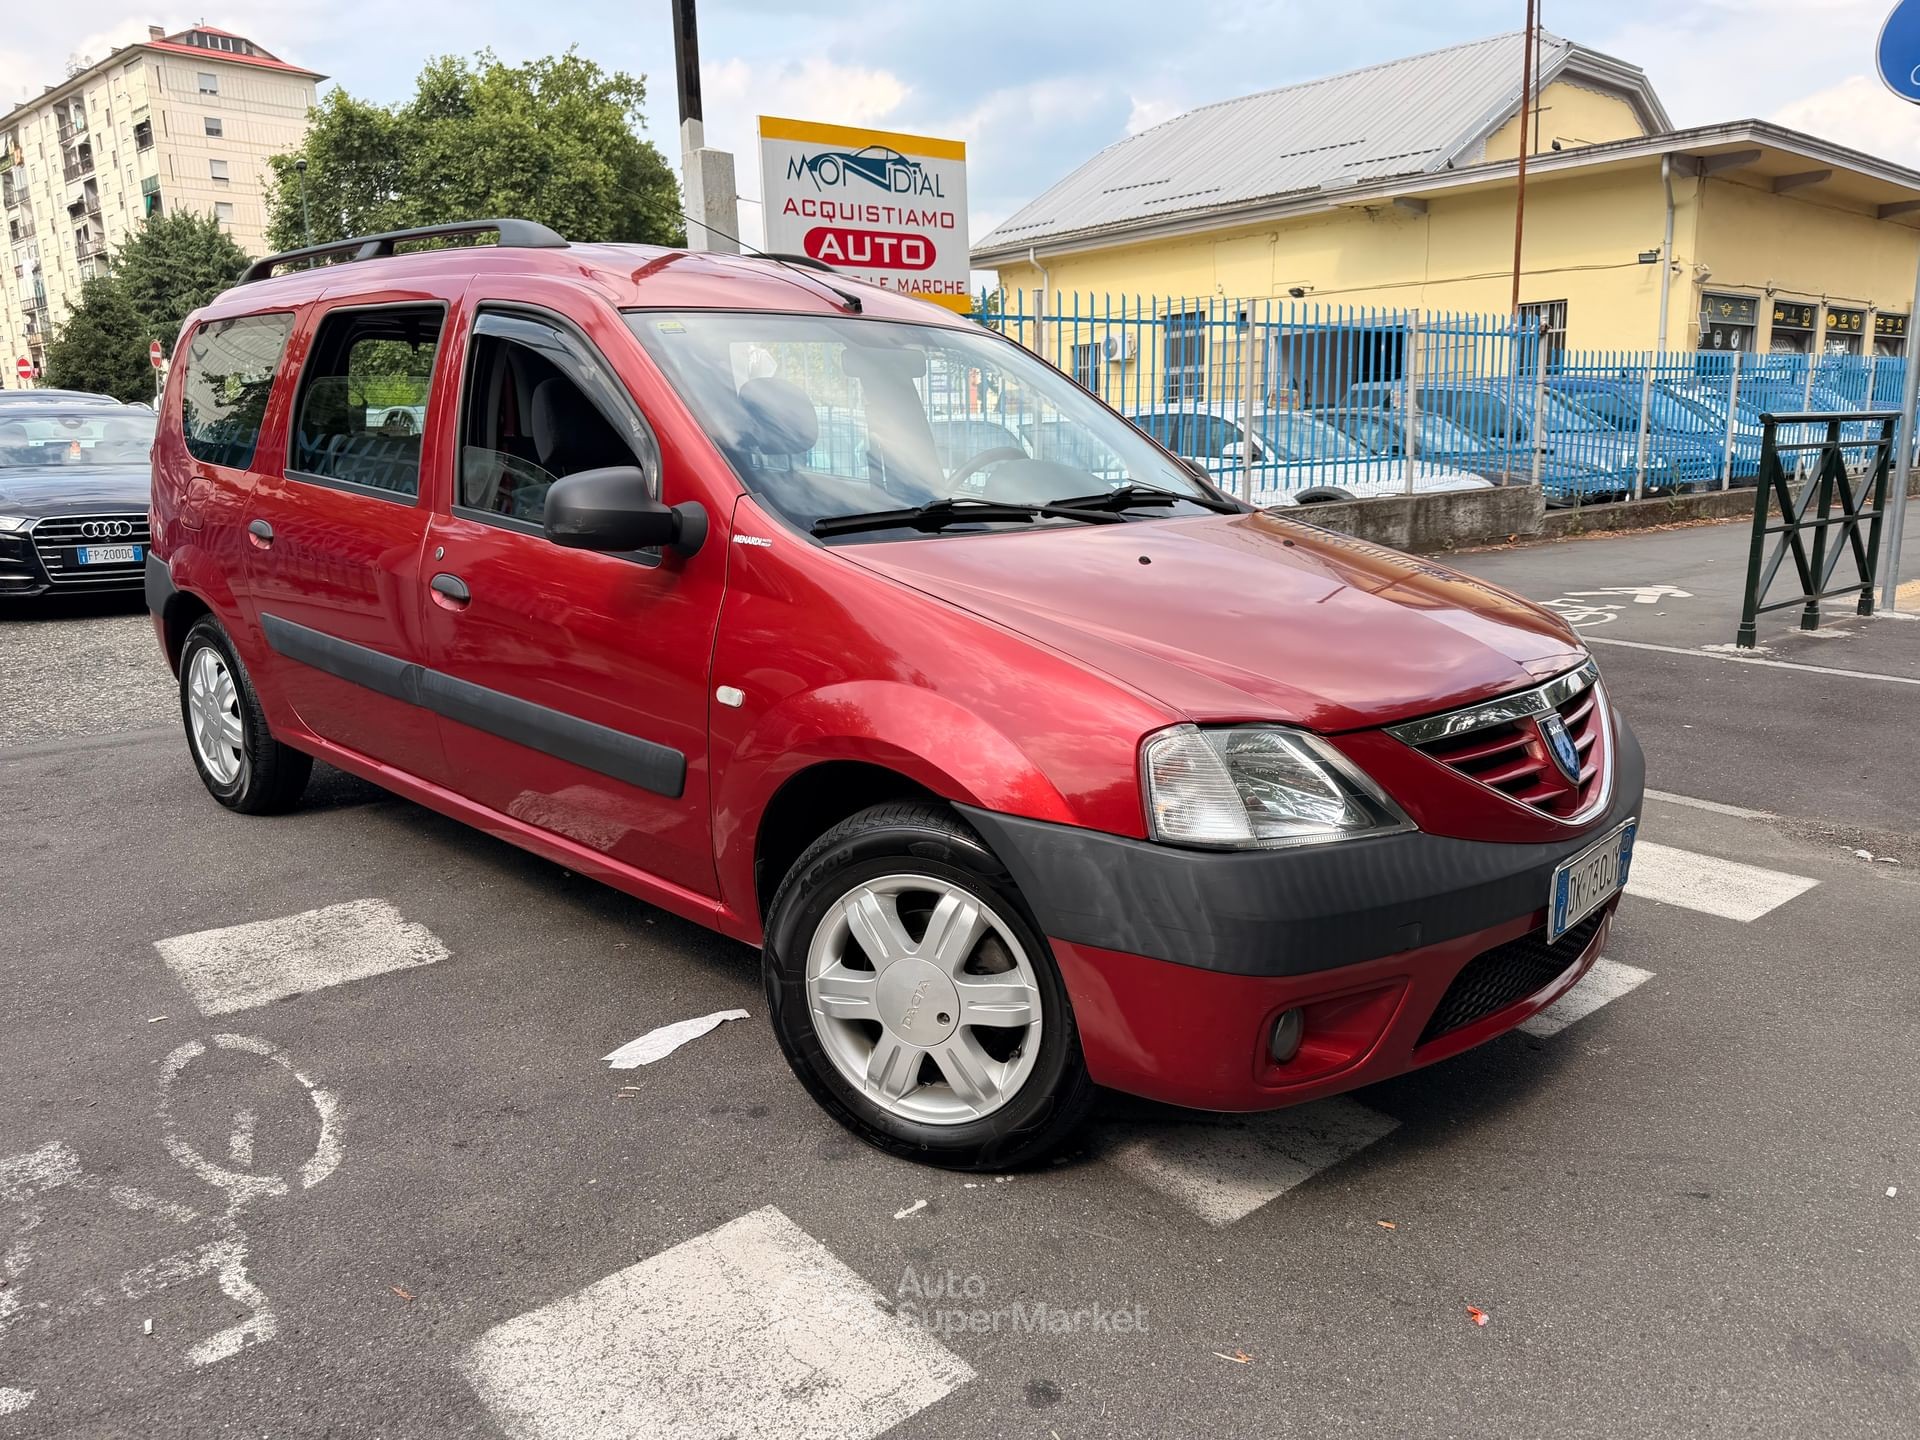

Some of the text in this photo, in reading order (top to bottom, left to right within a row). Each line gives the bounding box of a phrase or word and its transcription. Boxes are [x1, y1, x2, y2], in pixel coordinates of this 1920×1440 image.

[783, 197, 955, 229] ACQUISTIAMO
[817, 233, 926, 265] AUTO
[897, 278, 965, 294] MARCHE
[902, 979, 931, 1030] DACIA
